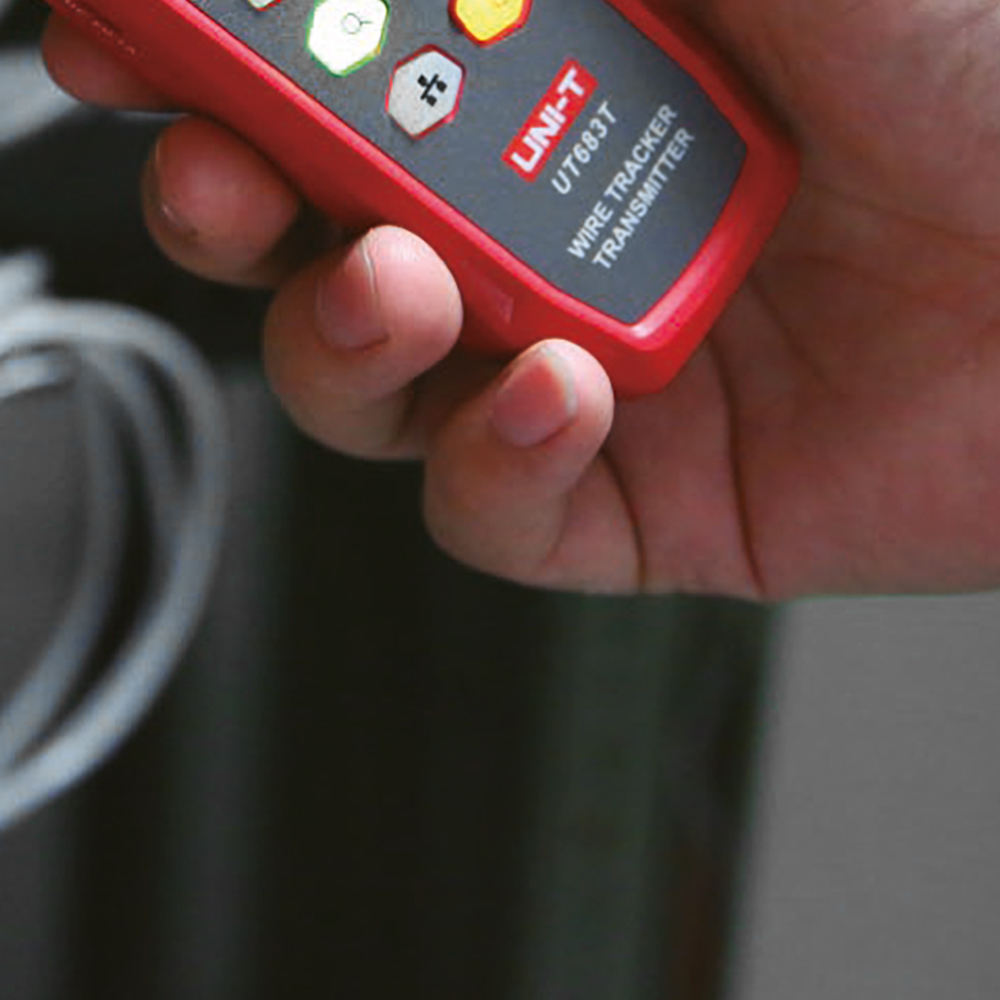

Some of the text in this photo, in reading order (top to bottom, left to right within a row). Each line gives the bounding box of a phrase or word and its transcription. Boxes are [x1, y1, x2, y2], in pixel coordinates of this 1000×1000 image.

[511, 67, 585, 172] UNI-T
[551, 101, 616, 195] UT683T
[567, 103, 678, 259] WIRE TRACKER
[592, 128, 695, 269] TRANSMITTER
